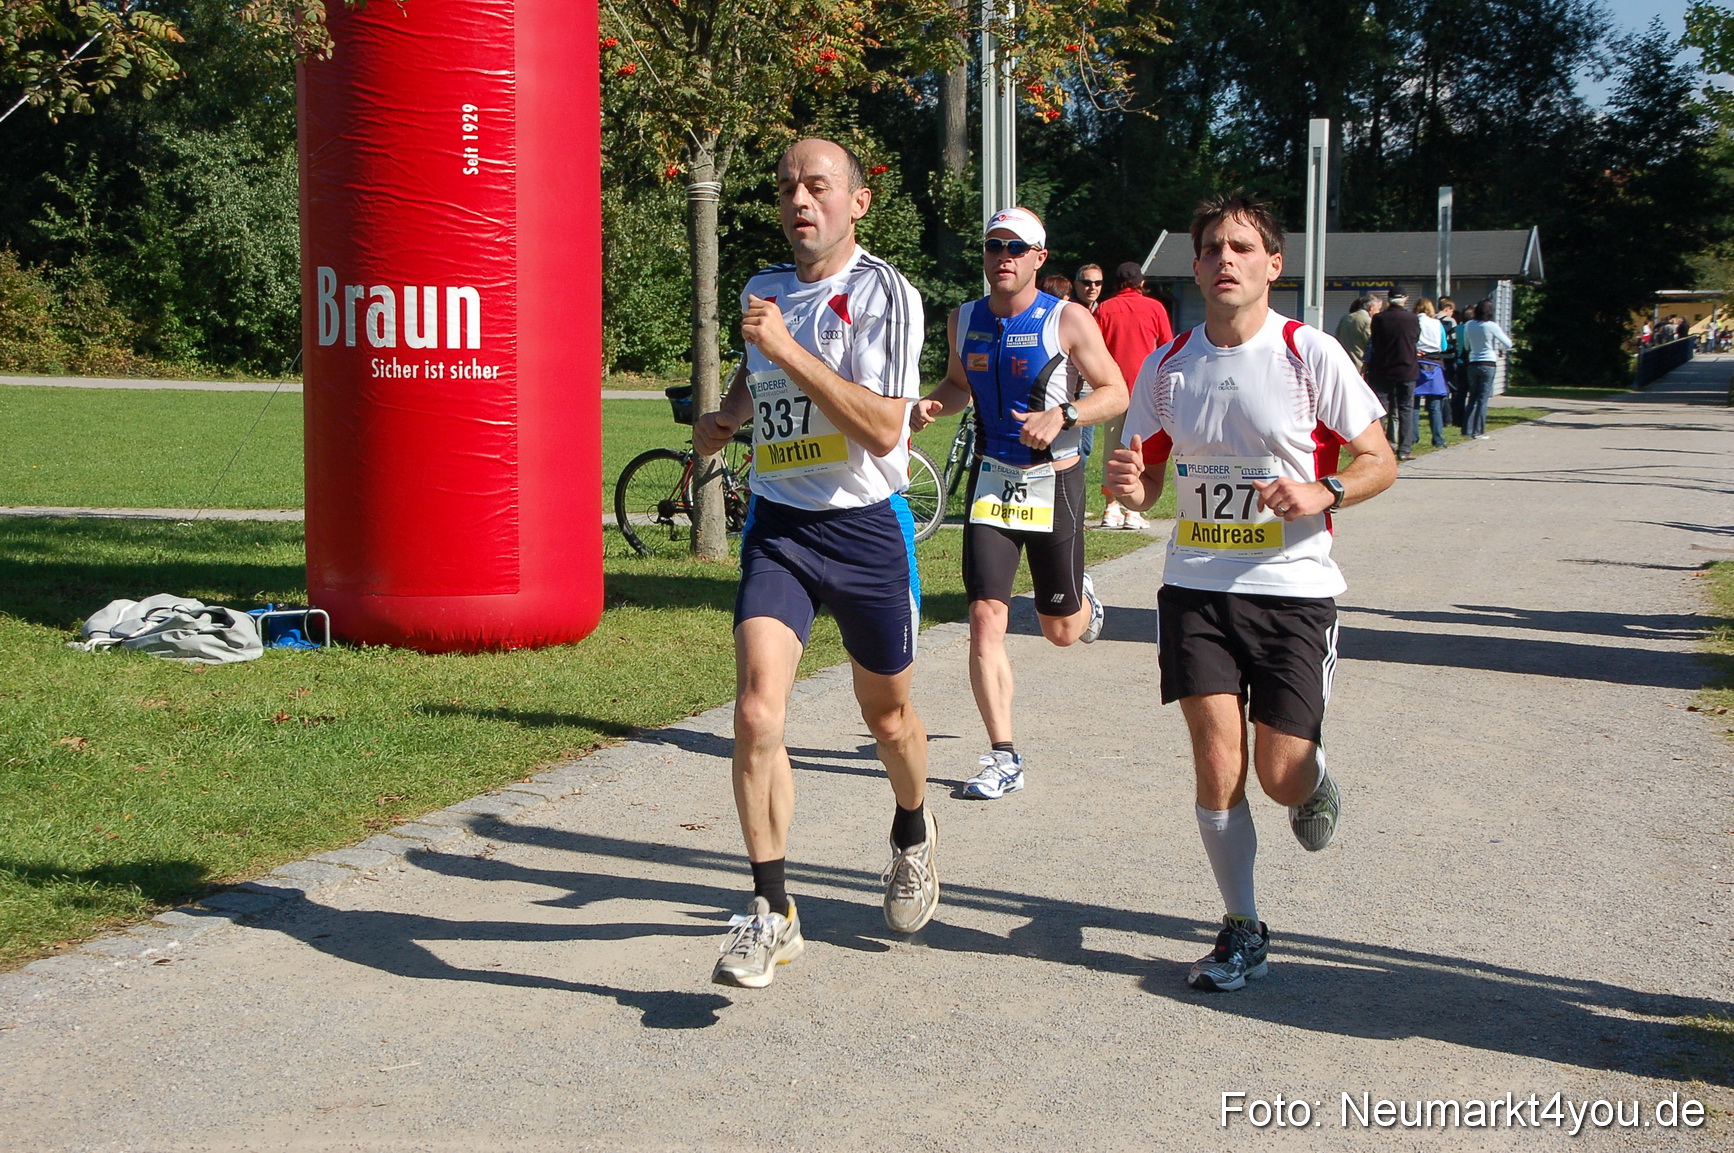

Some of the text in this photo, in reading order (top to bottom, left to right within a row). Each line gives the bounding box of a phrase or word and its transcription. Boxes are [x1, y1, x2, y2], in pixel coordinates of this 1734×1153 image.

[462, 103, 479, 175] Seit 1929
[317, 266, 481, 350] Braun
[371, 357, 500, 379] Sicher ist sicher
[759, 396, 812, 441] 337
[768, 440, 822, 465] Martin
[1188, 463, 1230, 475] PFLEIDERER
[1001, 479, 1028, 503] 85
[1195, 483, 1256, 520] 127
[991, 503, 1034, 521] Daniel
[1191, 522, 1265, 544] Andreas
